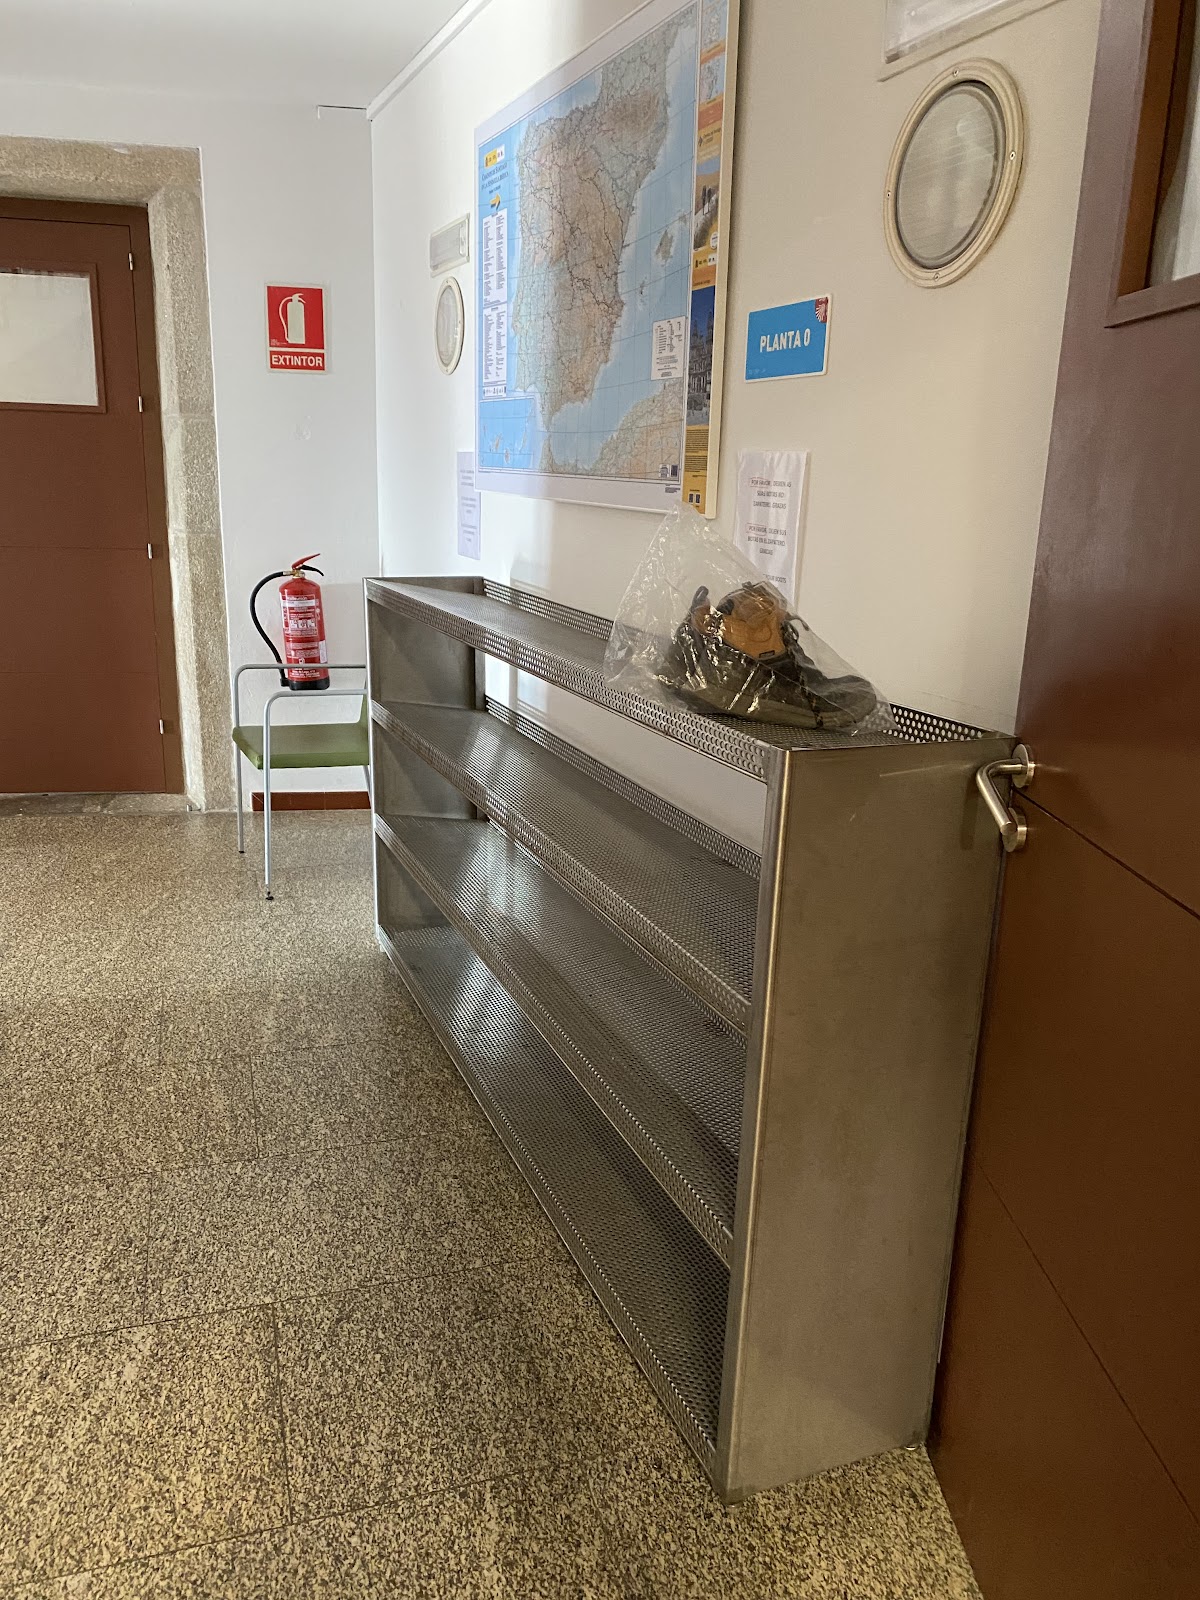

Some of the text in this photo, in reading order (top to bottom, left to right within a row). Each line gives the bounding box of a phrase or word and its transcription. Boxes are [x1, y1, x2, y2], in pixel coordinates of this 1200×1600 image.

[760, 328, 811, 353] PLANTA 0
[271, 355, 323, 367] EXTINTOR
